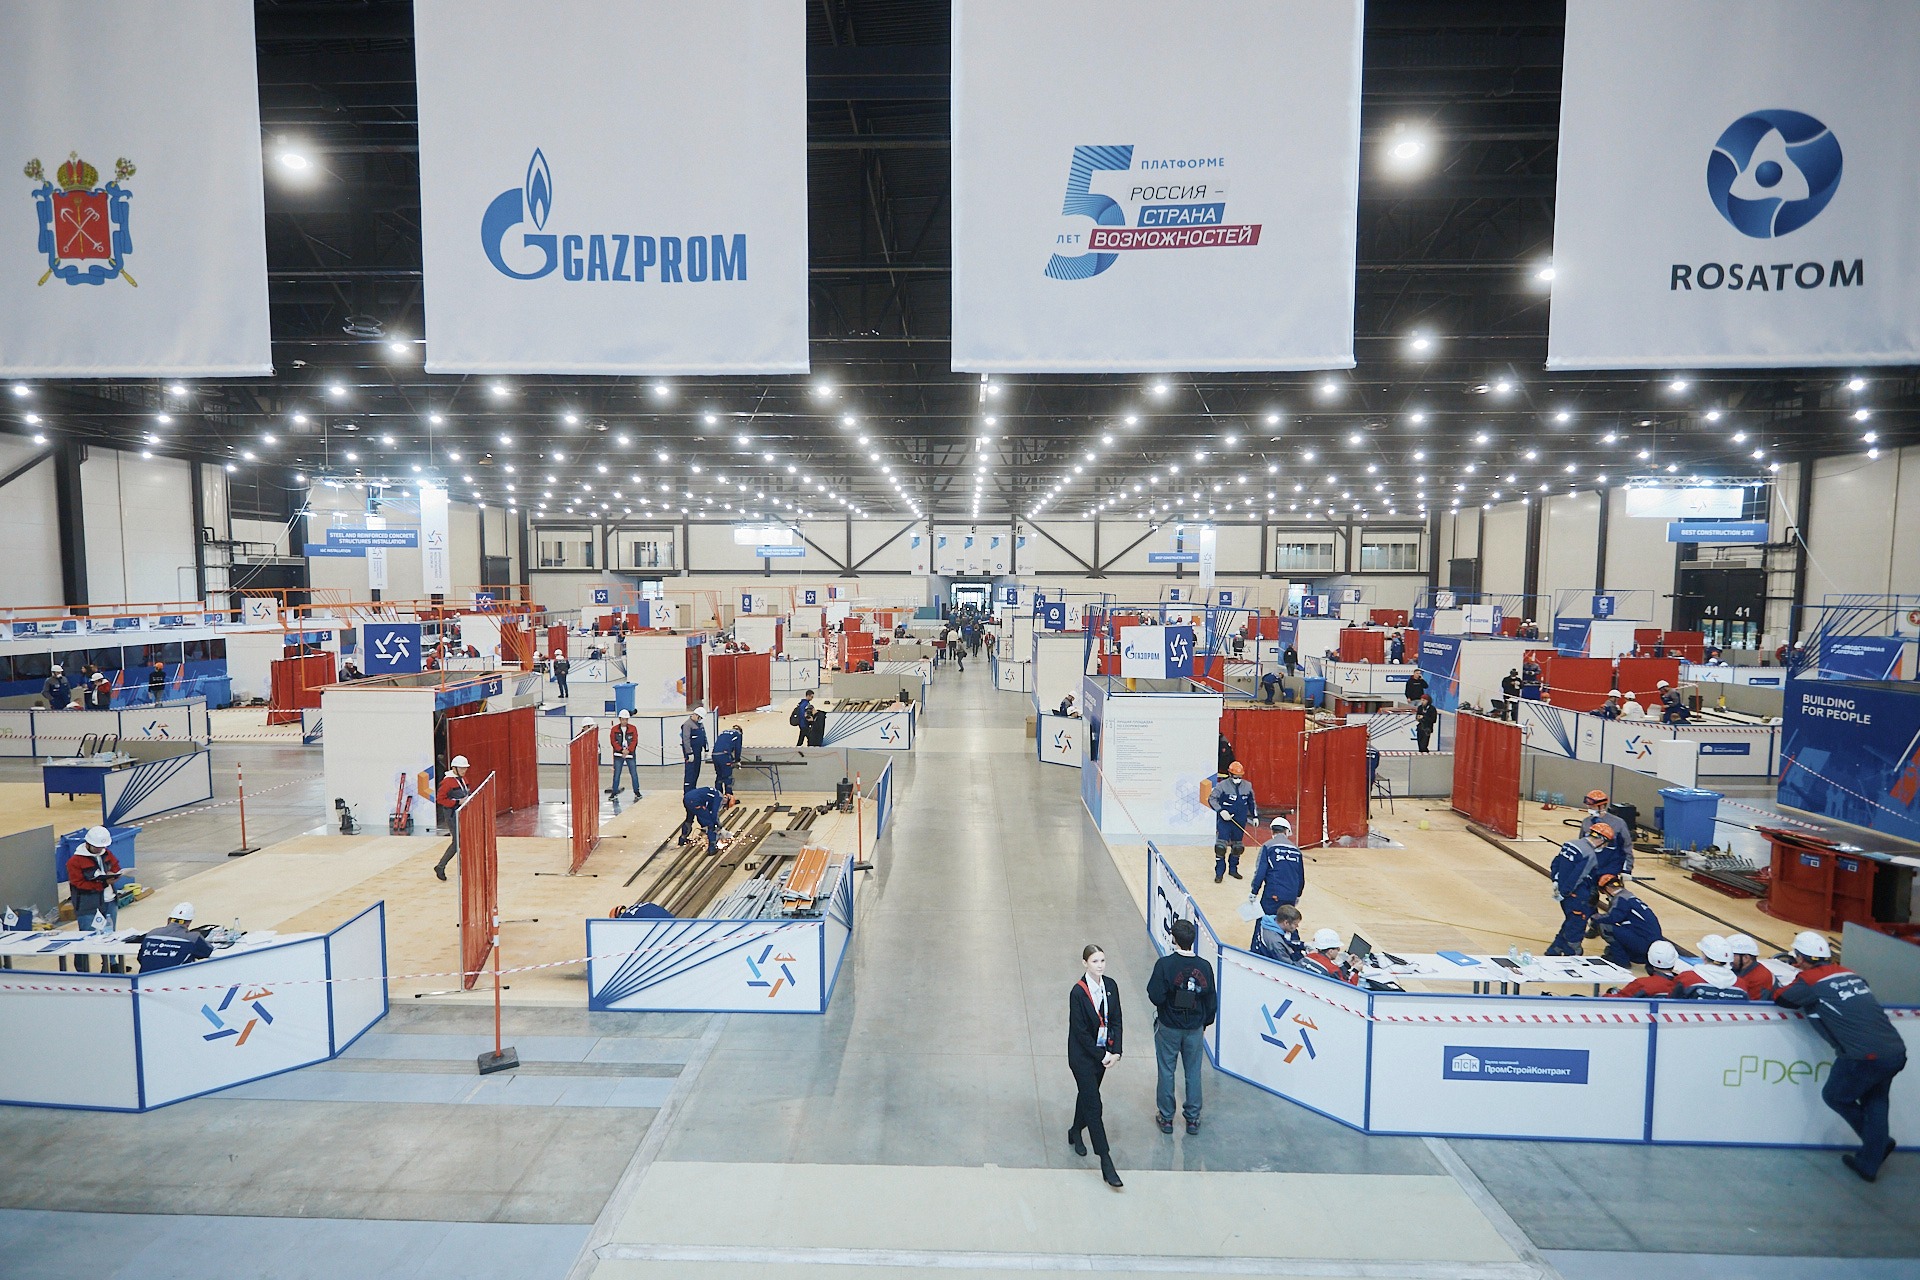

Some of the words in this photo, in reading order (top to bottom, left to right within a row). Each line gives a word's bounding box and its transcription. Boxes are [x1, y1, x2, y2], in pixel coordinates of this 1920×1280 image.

[1140, 157, 1225, 170] ПЛАТФОРМЕ
[1130, 185, 1207, 201] РОССИЯ
[1143, 206, 1217, 225] СТРАНА
[1056, 234, 1081, 244] ЛЕТ
[1094, 225, 1253, 247] ВОЗМОЖНОСТЕЙ
[562, 233, 747, 283] GAZPROM
[1670, 258, 1864, 292] ROSATOM
[1705, 606, 1719, 616] 41
[1735, 607, 1750, 617] 41
[1134, 652, 1160, 660] ГАЗПРОМ
[1802, 693, 1855, 710] BUILDING
[1801, 705, 1824, 717] FOR
[1826, 708, 1872, 725] PEOPLE
[1454, 1062, 1478, 1070] ПСК
[1484, 1065, 1571, 1077] ПромСтройКонтракт
